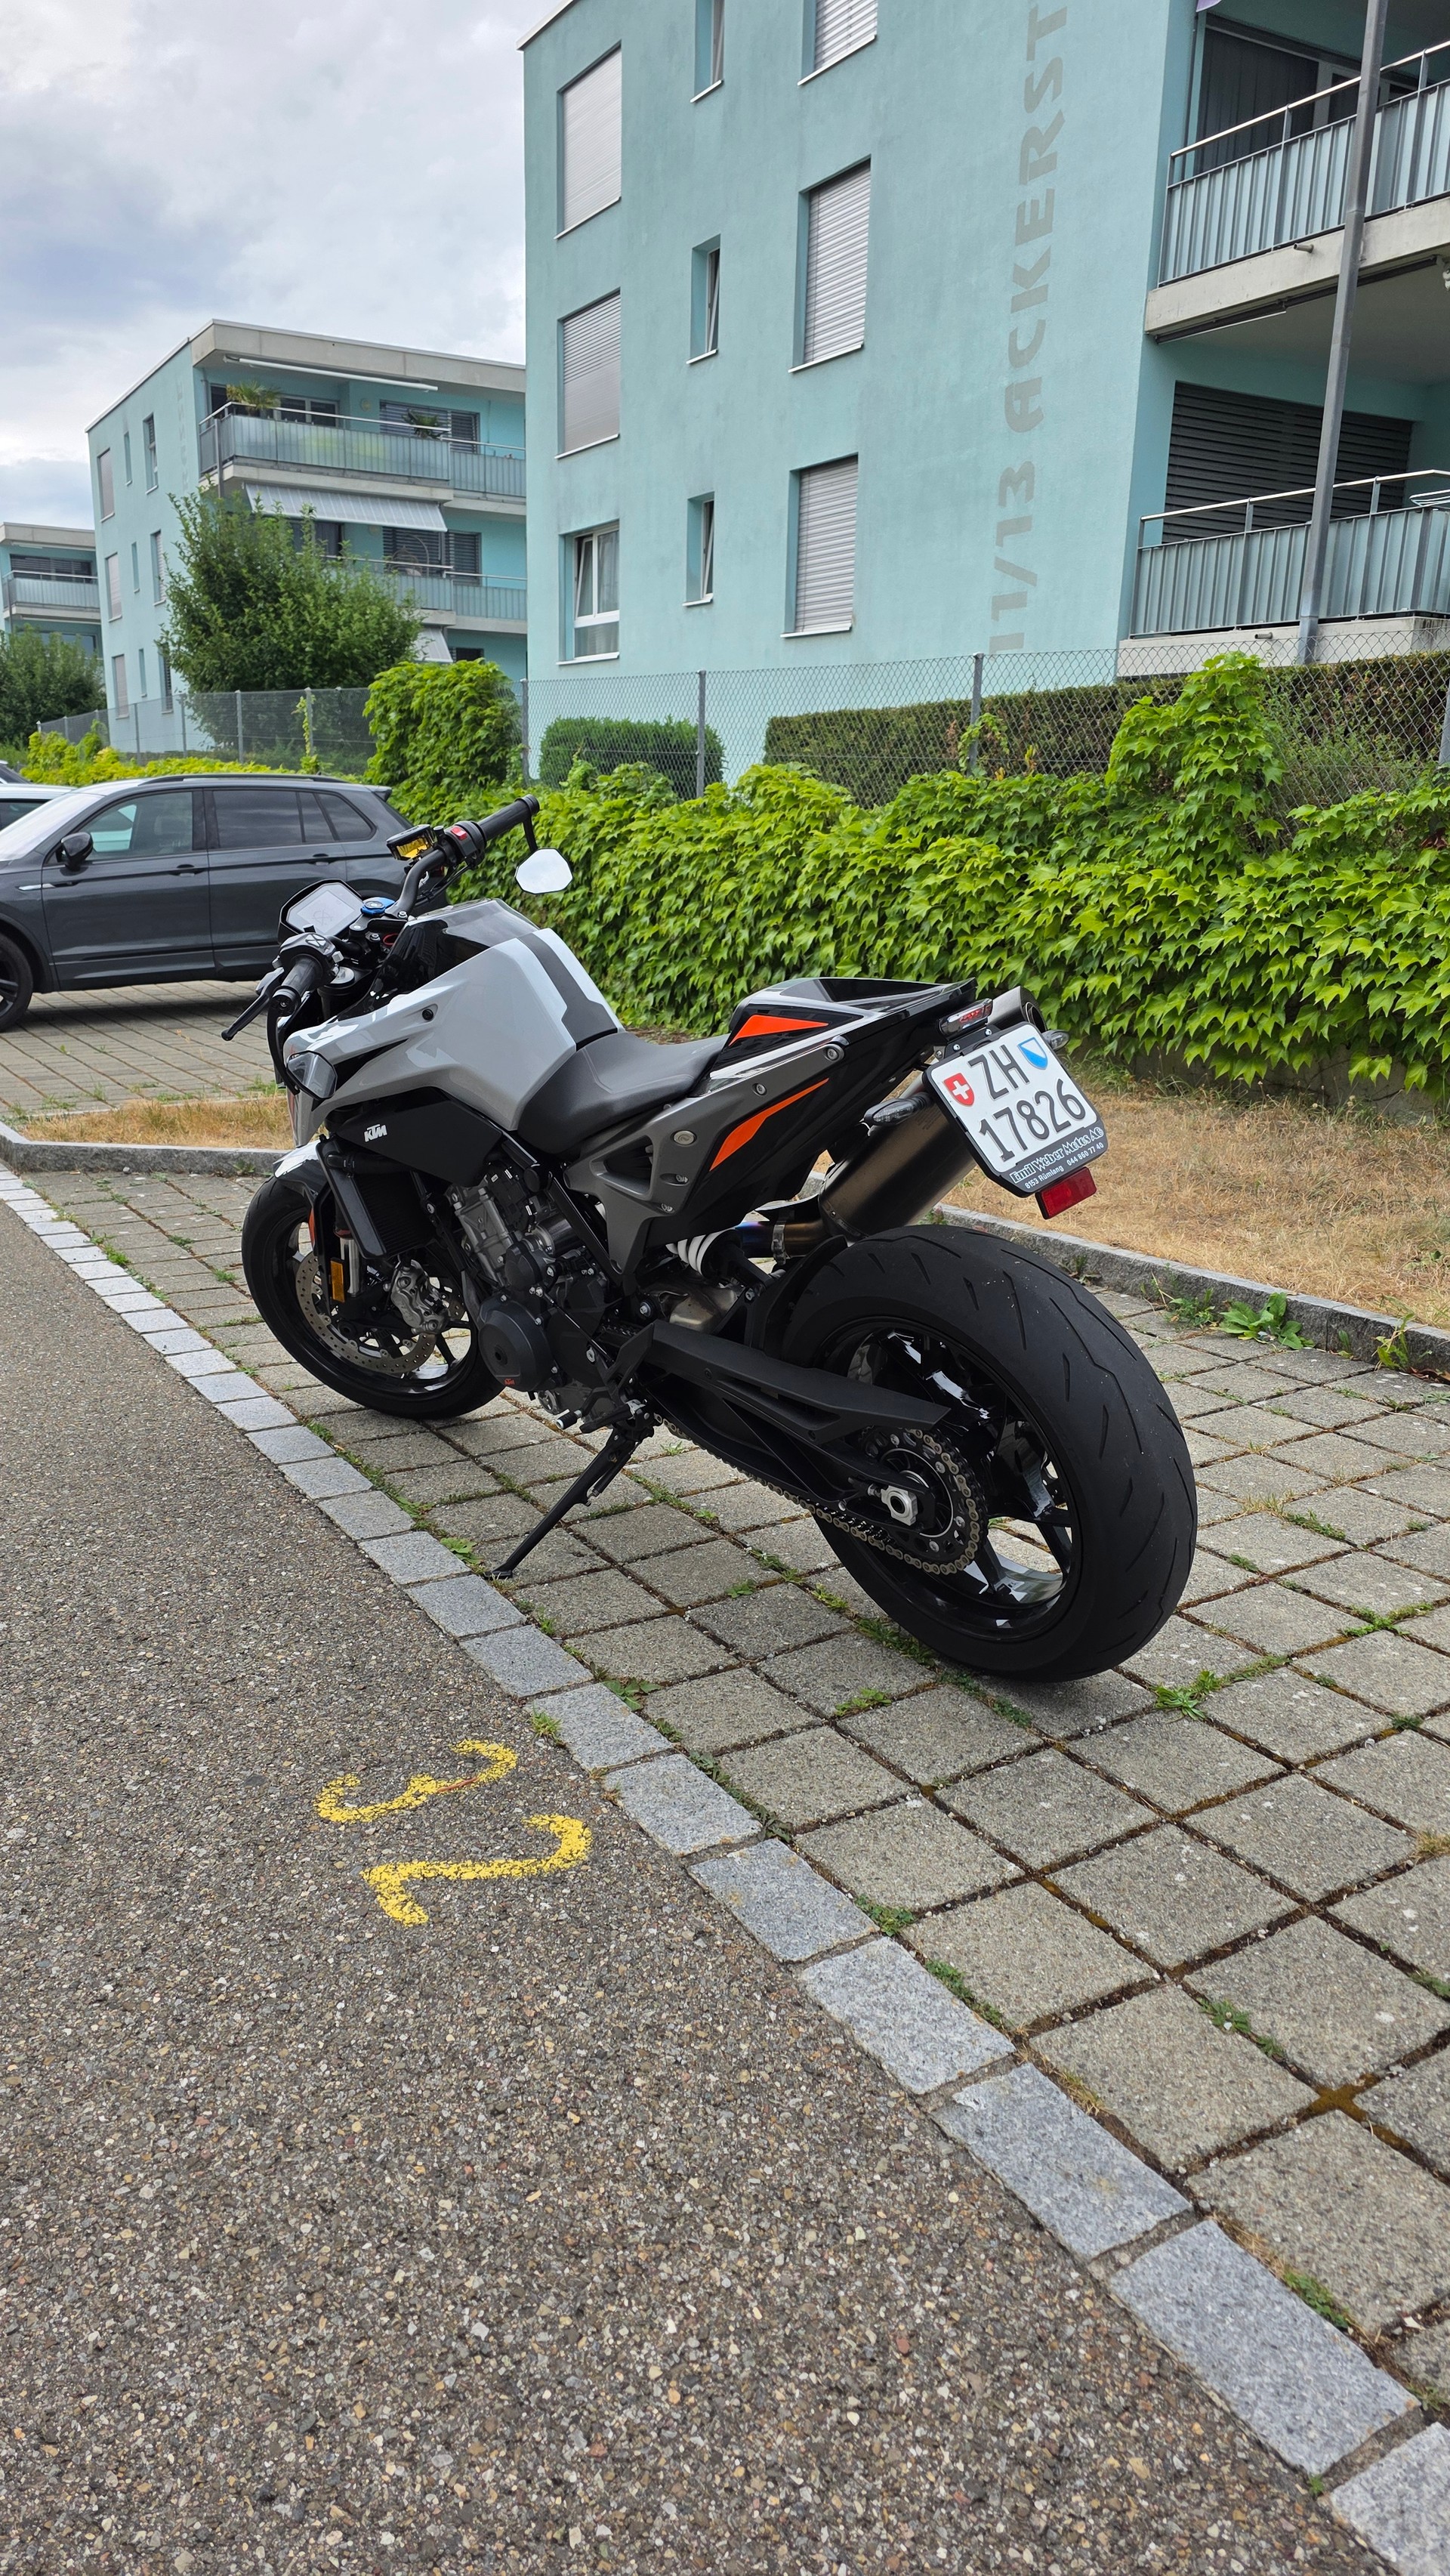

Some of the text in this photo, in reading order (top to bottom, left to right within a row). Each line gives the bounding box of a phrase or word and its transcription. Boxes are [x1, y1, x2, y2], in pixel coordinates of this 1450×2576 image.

[967, 1044, 1030, 1100] ZH
[364, 1123, 387, 1142] KTM
[979, 1078, 1086, 1163] 17826
[1009, 1126, 1104, 1184] Emil Weber Motos AG
[1024, 1141, 1104, 1189] 8153 Rümlang 044 860 77 40
